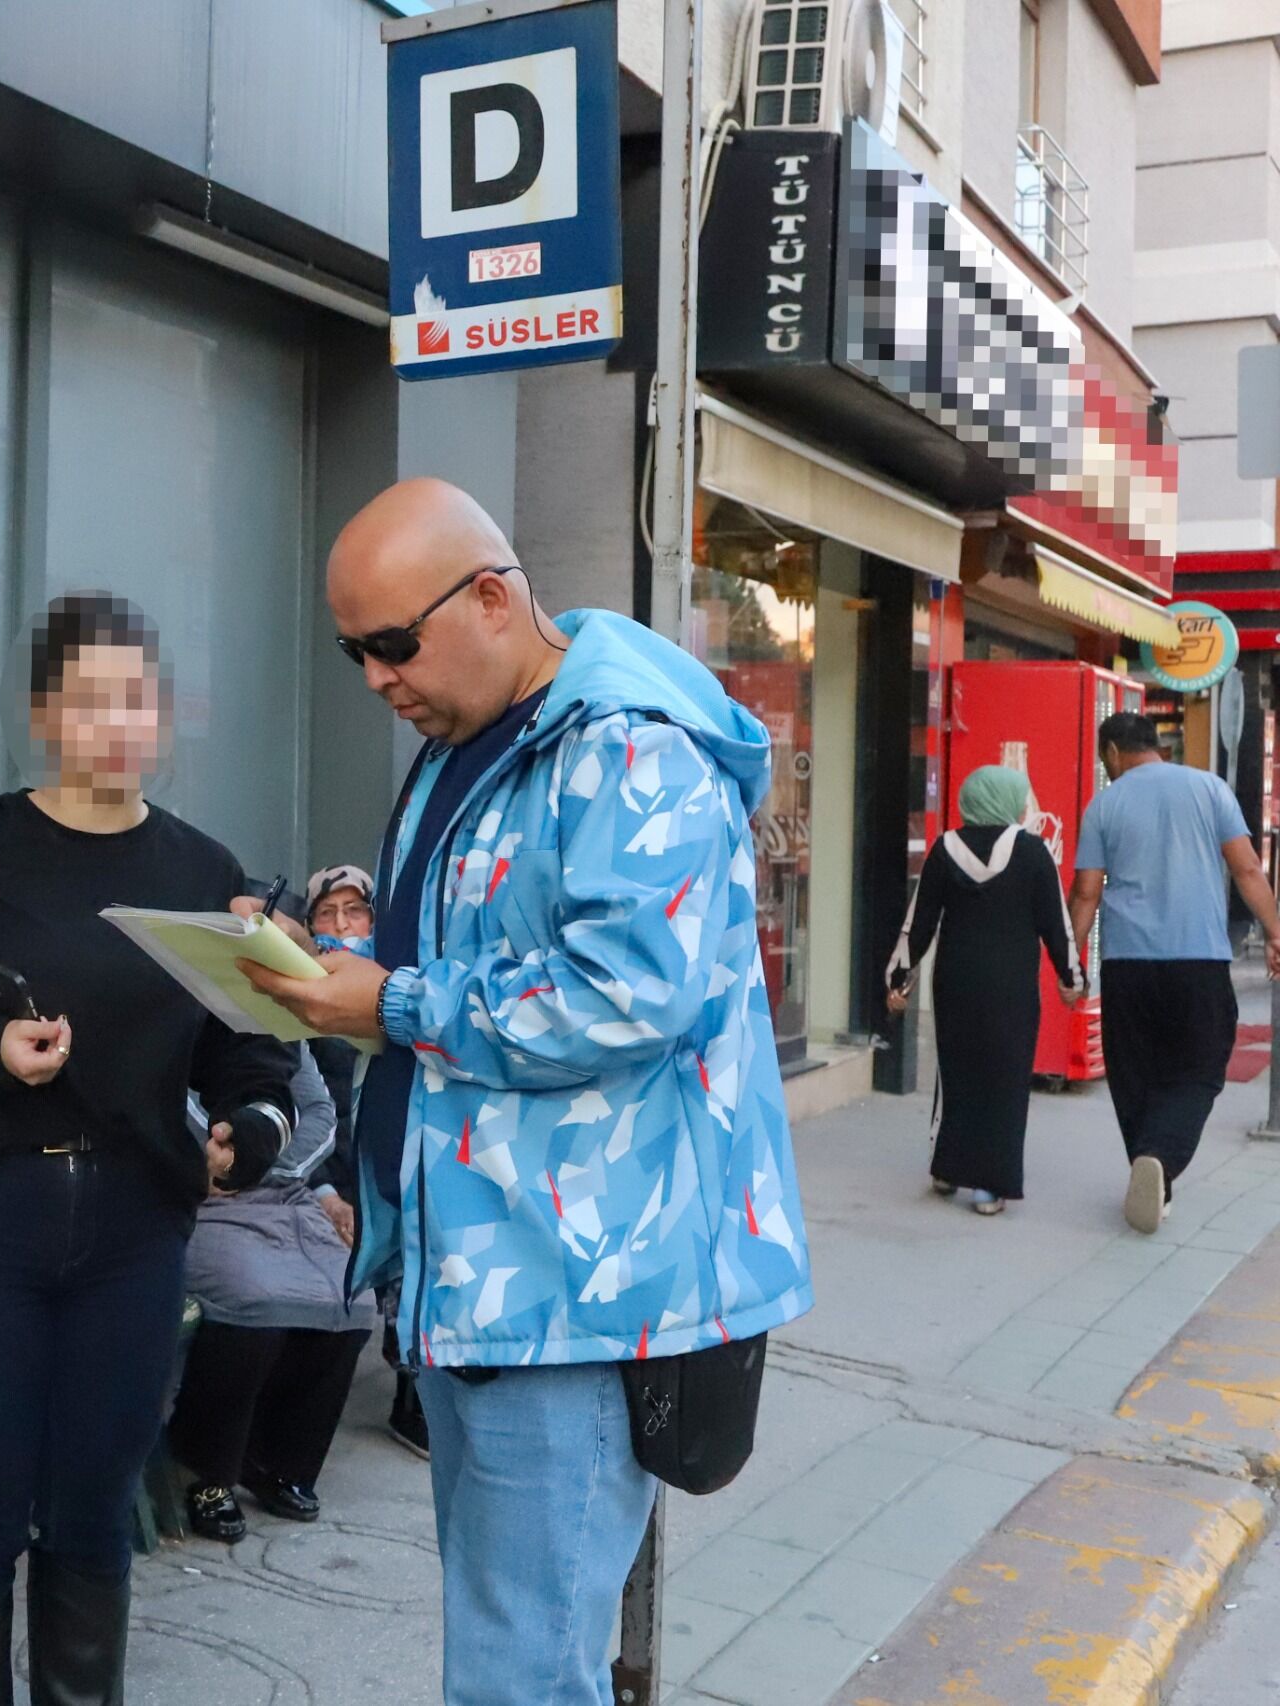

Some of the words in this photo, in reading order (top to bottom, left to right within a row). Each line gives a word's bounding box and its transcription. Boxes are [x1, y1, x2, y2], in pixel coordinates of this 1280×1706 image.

[450, 82, 545, 212] D
[475, 251, 538, 280] 1326
[764, 155, 810, 353] TÜTÜNCÜ
[466, 308, 599, 350] SÜSLER
